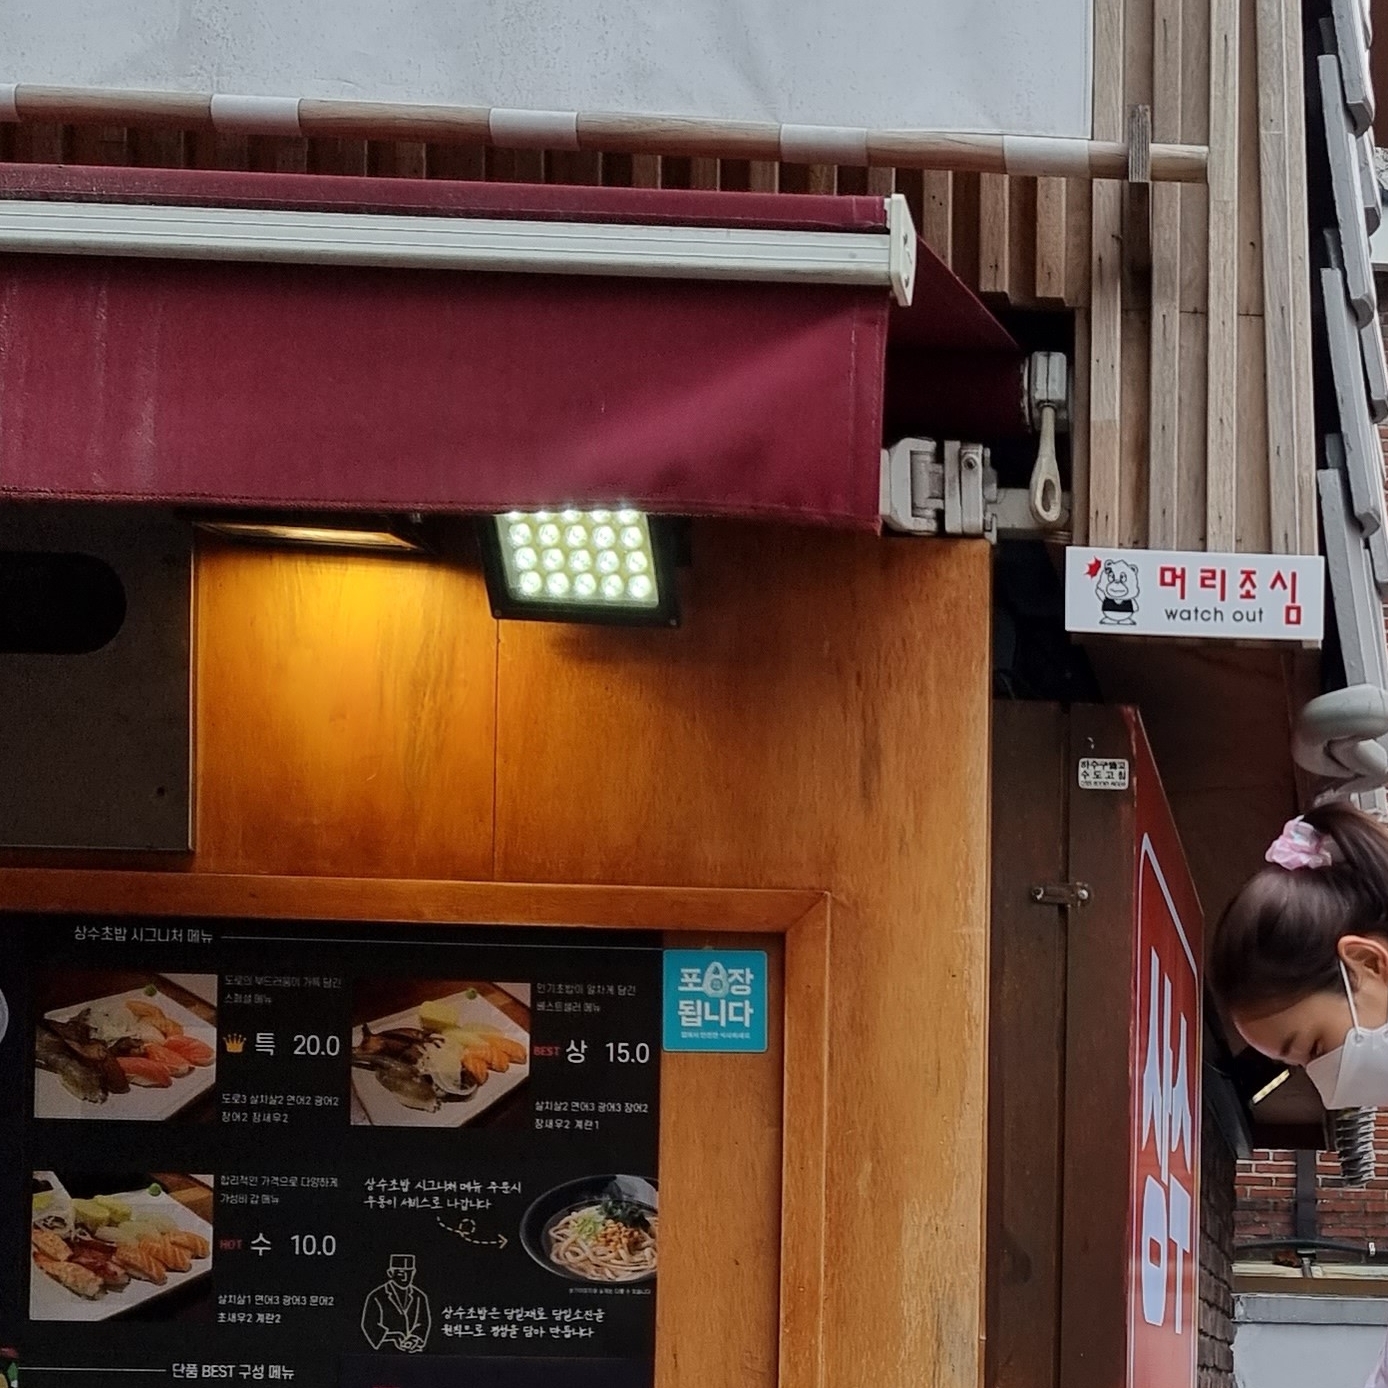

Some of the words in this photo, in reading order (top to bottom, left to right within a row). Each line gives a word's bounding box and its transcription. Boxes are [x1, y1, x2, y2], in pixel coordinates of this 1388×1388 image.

[1158, 566, 1302, 626] 머리조심
[1164, 606, 1224, 623] watch
[1232, 608, 1264, 623] out
[74, 925, 127, 942] 상수초밥
[130, 926, 184, 943] 시그니처
[187, 928, 214, 944] 메뉴
[678, 966, 754, 996] 포장
[678, 1000, 754, 1028] 됩니다
[254, 1032, 276, 1056] 특
[292, 1034, 340, 1056] 20.0
[565, 1039, 588, 1064] 상
[604, 1042, 650, 1064] 15.0
[1140, 946, 1192, 1334] 상수
[364, 1178, 411, 1193] 상수초밥
[459, 1180, 483, 1194] 메뉴
[363, 1195, 397, 1209] 우동이
[400, 1196, 444, 1209] 서비스로
[446, 1197, 492, 1211] 나갑니다
[250, 1232, 272, 1257] 수
[290, 1234, 336, 1256] 10.0
[441, 1306, 501, 1320] 상수초밥은
[172, 1362, 198, 1380] 단품
[202, 1365, 236, 1378] BEST
[238, 1364, 264, 1380] 구성
[268, 1365, 296, 1380] 메뉴
